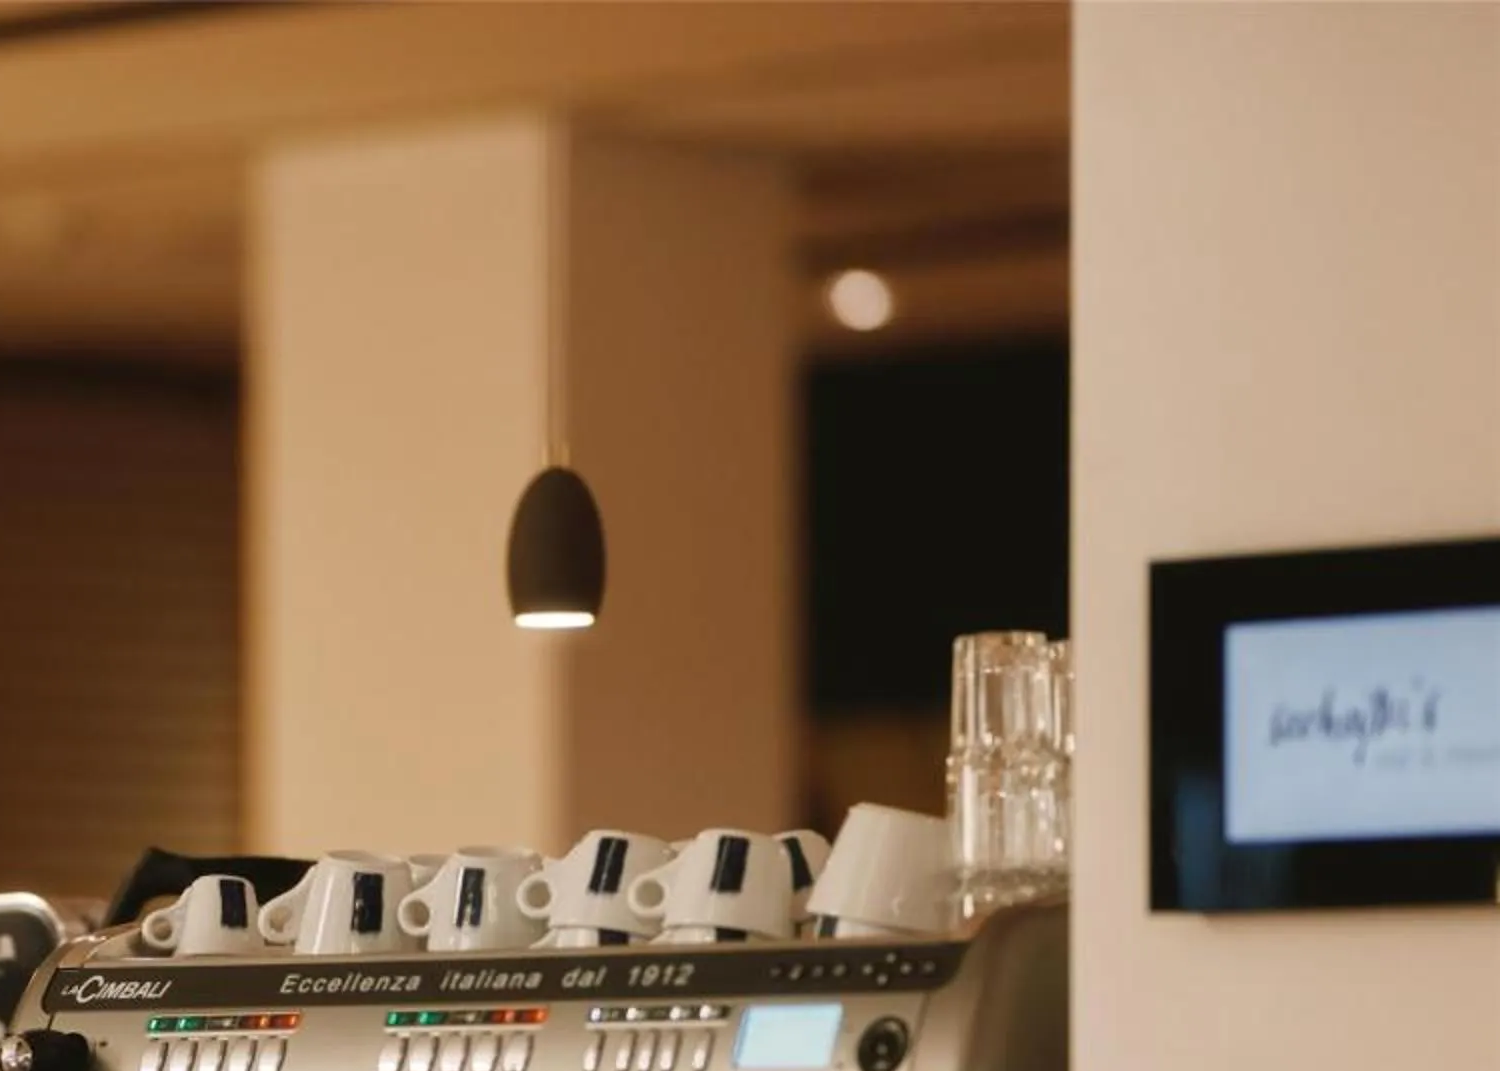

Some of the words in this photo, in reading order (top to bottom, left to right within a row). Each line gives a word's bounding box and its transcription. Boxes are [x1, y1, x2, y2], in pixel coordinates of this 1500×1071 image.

[279, 971, 422, 994] Eccellenza
[438, 968, 543, 992] italiana
[561, 964, 608, 988] dal
[627, 962, 695, 987] 1912
